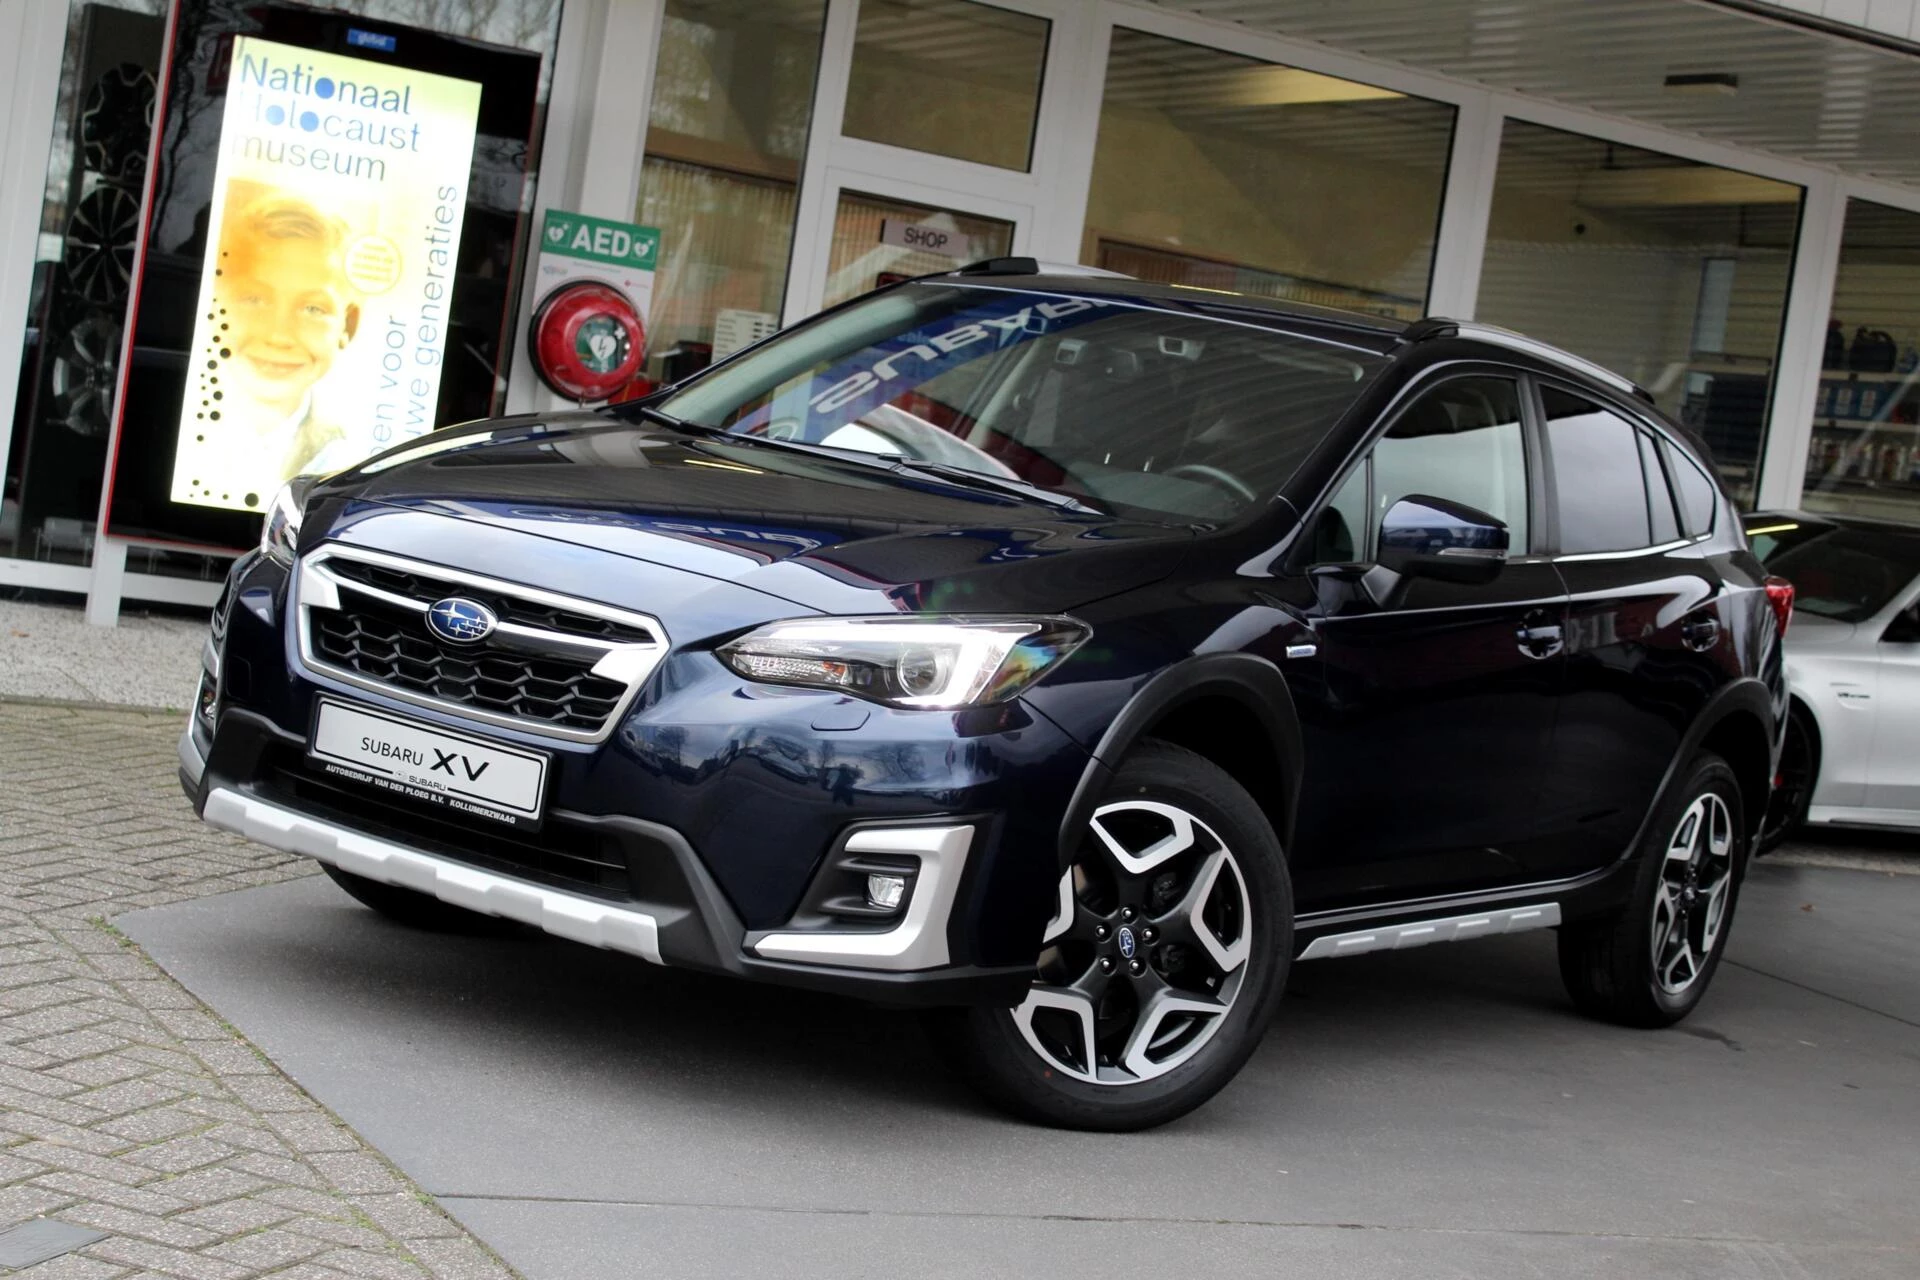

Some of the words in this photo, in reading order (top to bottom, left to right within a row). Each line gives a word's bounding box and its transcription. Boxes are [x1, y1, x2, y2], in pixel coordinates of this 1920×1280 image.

[241, 53, 411, 115] Nationaal
[232, 132, 386, 182] museum
[571, 224, 631, 258] AED
[903, 227, 949, 249] SHOP
[414, 185, 458, 366] generaties
[380, 315, 407, 389] voor
[360, 736, 424, 766] SUBARU
[429, 748, 490, 782] XV
[408, 775, 447, 792] SUBARU
[325, 764, 373, 783] AUTOBEDRIJF
[375, 777, 389, 788] VAN
[389, 782, 405, 793] DER
[405, 787, 430, 800] PLOEG
[430, 794, 444, 804] B.V.
[449, 799, 516, 824] KOLLUMERZWAAG
